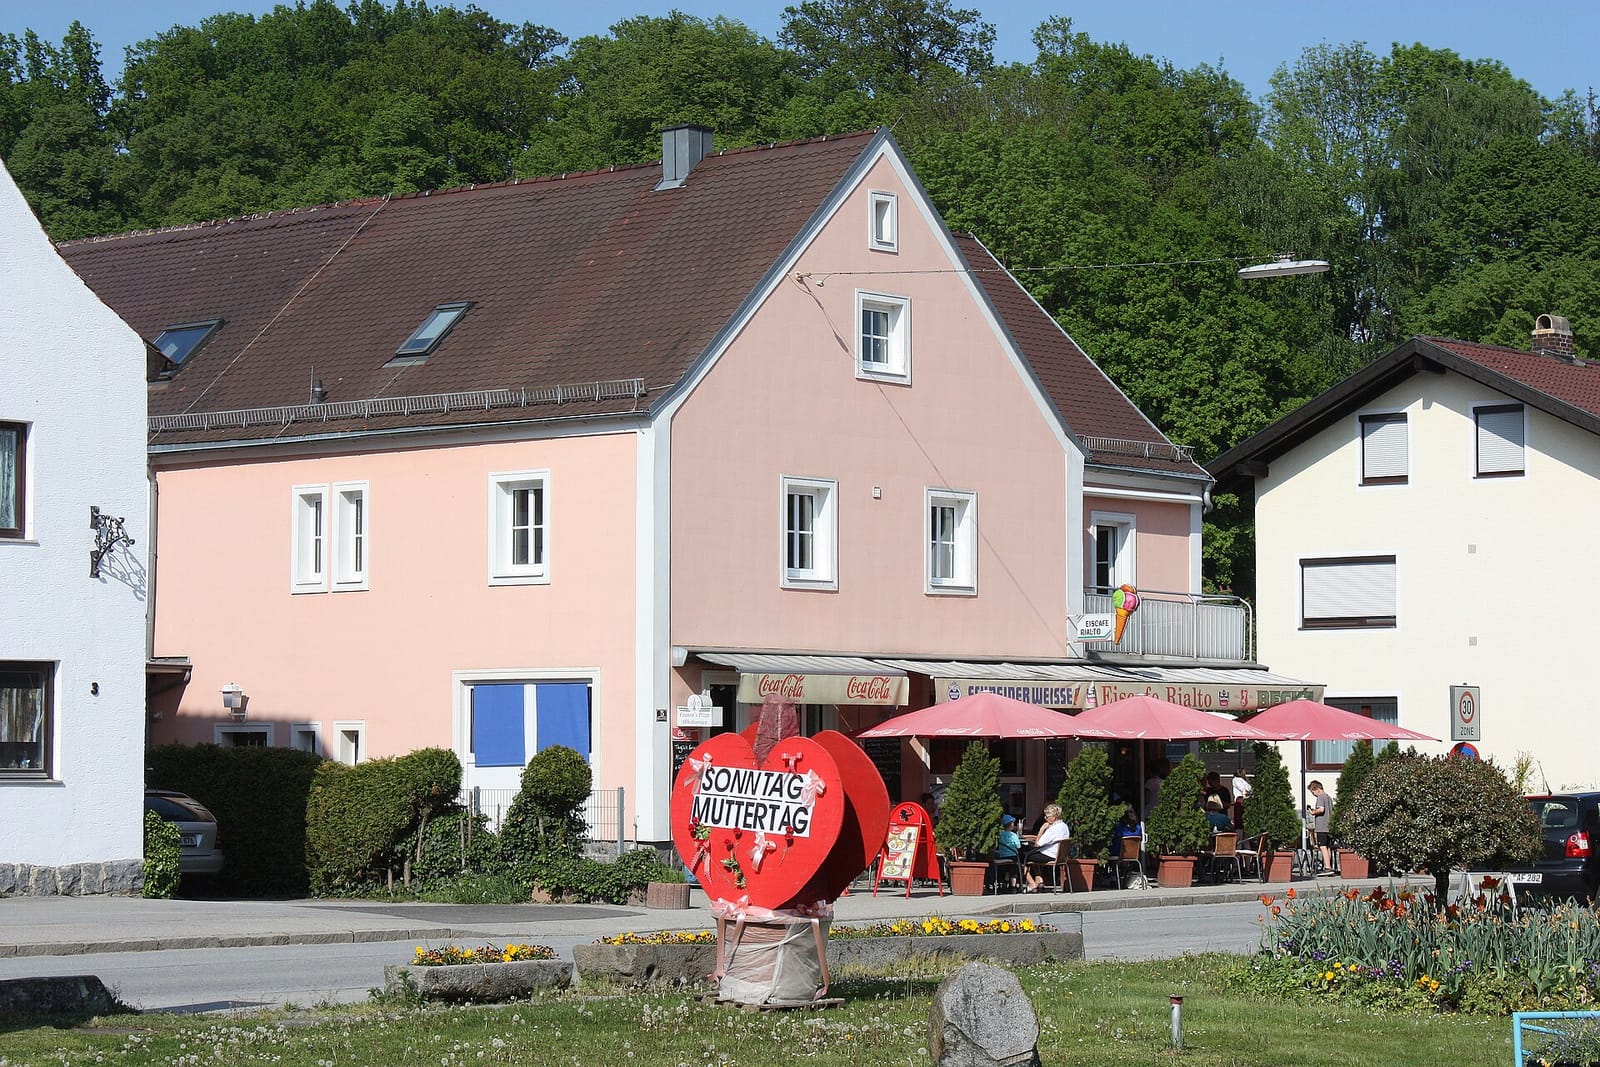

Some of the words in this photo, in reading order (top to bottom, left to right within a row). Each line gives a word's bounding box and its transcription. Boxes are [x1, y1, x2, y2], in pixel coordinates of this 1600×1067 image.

[1080, 628, 1102, 636] RIALTO
[91, 682, 99, 696] 3
[759, 674, 805, 699] Coca-Cola
[847, 676, 891, 700] Coca-Cola
[1032, 687, 1073, 705] WEISSE
[1165, 686, 1212, 708] Rialto
[1462, 700, 1472, 715] 30
[1460, 726, 1474, 736] ZONE
[702, 767, 804, 800] SONNTAG
[692, 796, 809, 834] MUTTERTAG
